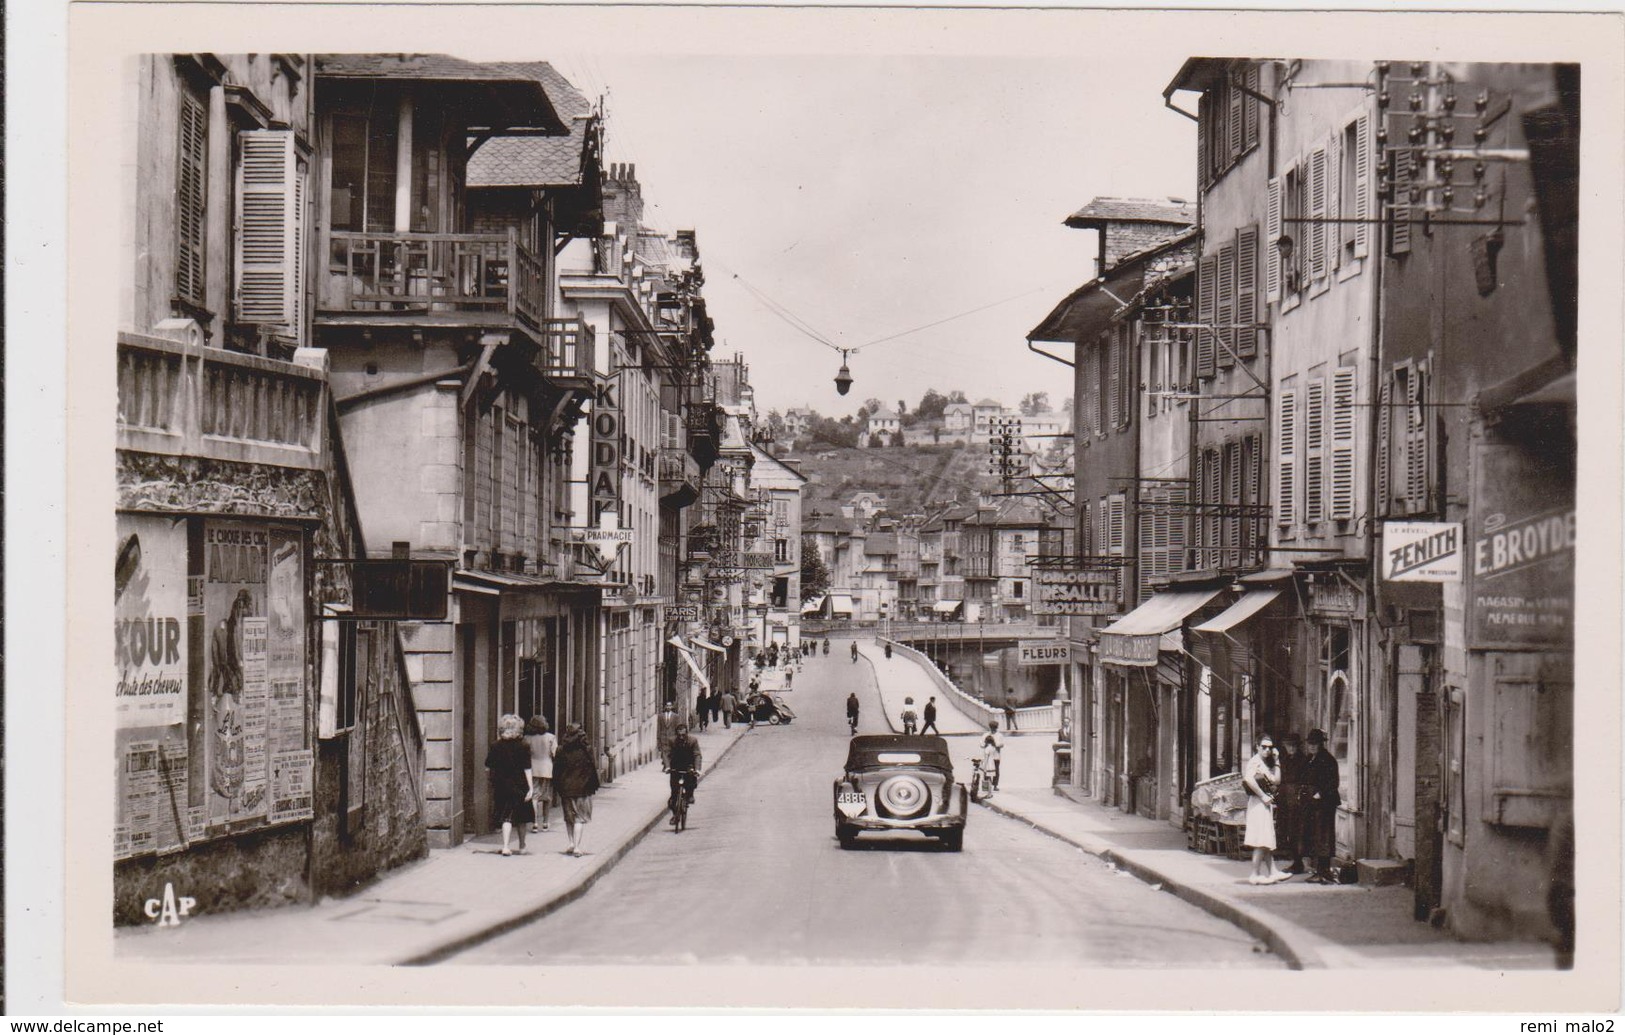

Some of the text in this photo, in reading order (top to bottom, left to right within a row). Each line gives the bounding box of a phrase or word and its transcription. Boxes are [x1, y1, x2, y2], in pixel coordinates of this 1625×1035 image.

[587, 530, 632, 541] PHARMACIE
[1389, 527, 1457, 579] ZENITH
[666, 607, 697, 617] PARIS
[1022, 647, 1068, 660] FLEURS
[138, 672, 153, 696] des
[837, 792, 866, 804] 4886
